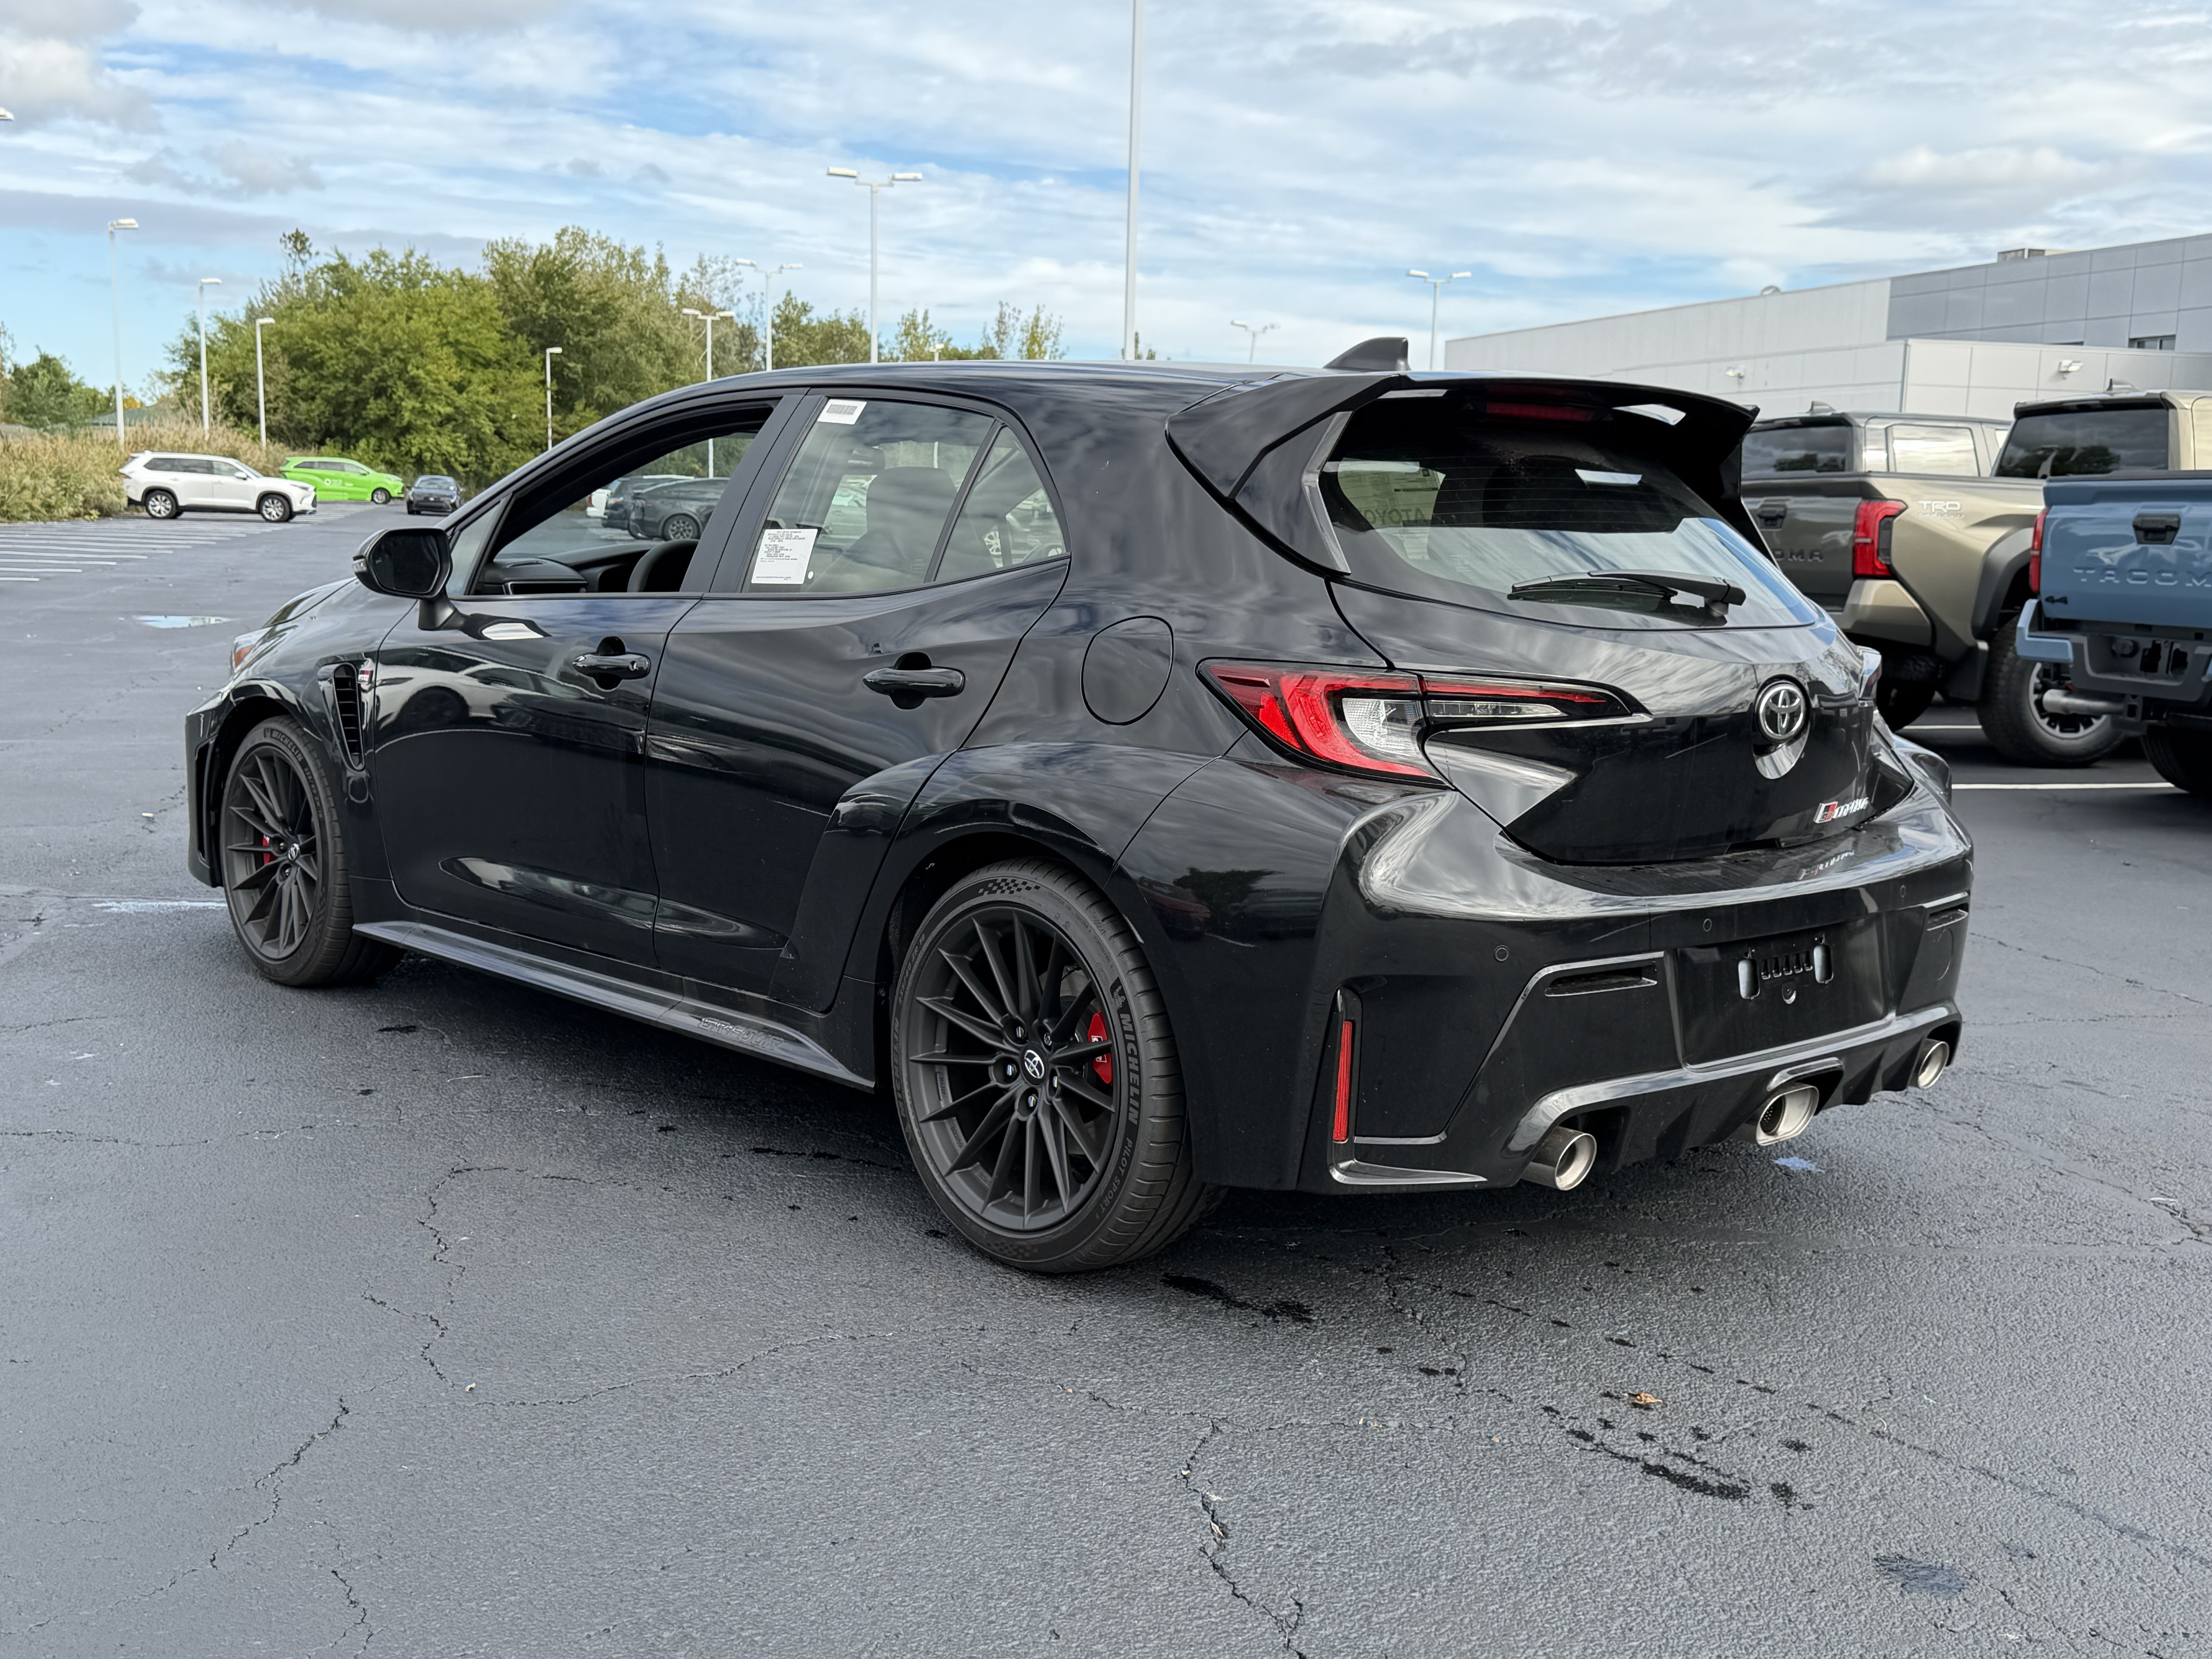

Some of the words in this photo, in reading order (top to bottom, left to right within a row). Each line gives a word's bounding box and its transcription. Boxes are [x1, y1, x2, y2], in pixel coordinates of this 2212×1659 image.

[1360, 508, 1426, 525] OYOTA
[1918, 501, 1960, 512] TRD
[272, 730, 304, 762] MICHELIN
[1120, 1013, 1140, 1125] MICHELIN
[1118, 1137, 1133, 1176] PILOT
[1100, 1176, 1120, 1213] SPORT
